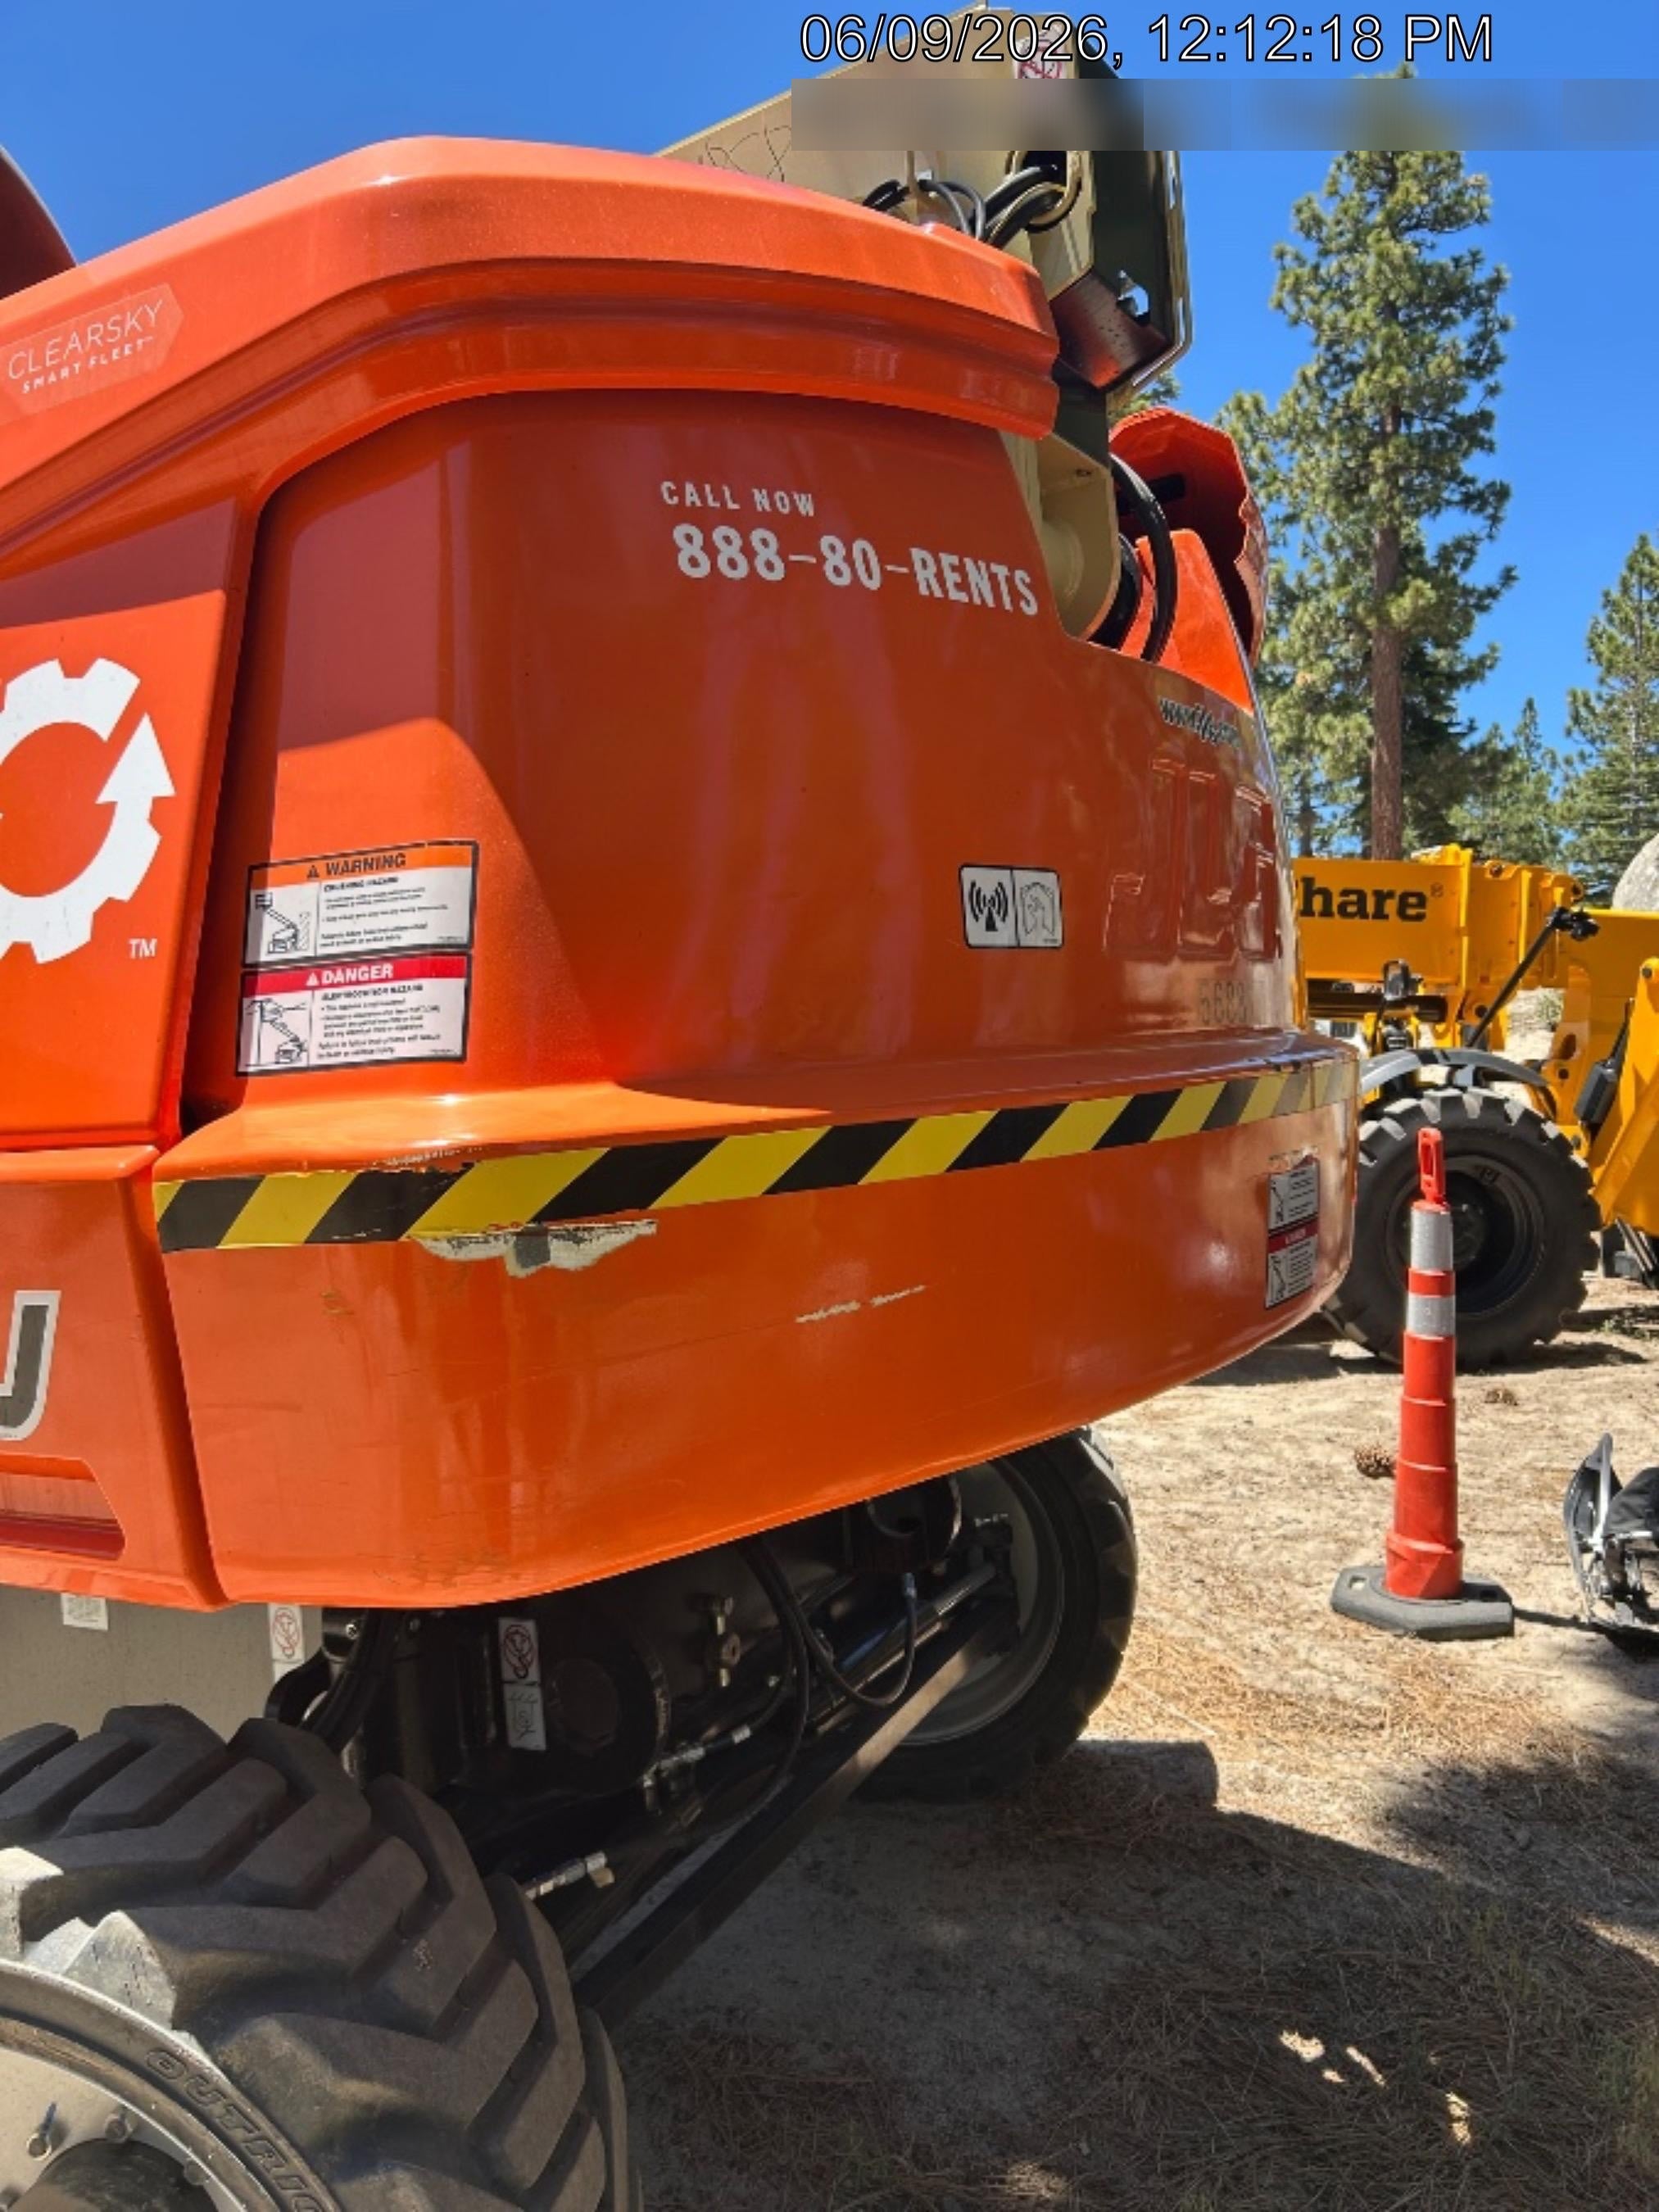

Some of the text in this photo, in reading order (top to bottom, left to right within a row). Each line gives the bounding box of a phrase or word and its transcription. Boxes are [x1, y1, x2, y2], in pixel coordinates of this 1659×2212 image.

[8, 299, 163, 379] CLEARSKY
[22, 338, 146, 394] SMART FLEET
[660, 480, 815, 517] CALL NOW
[673, 523, 1038, 615] 888-80-RENTS
[325, 853, 406, 877] WARNING
[129, 938, 157, 959] TM
[322, 963, 394, 984] DANGER
